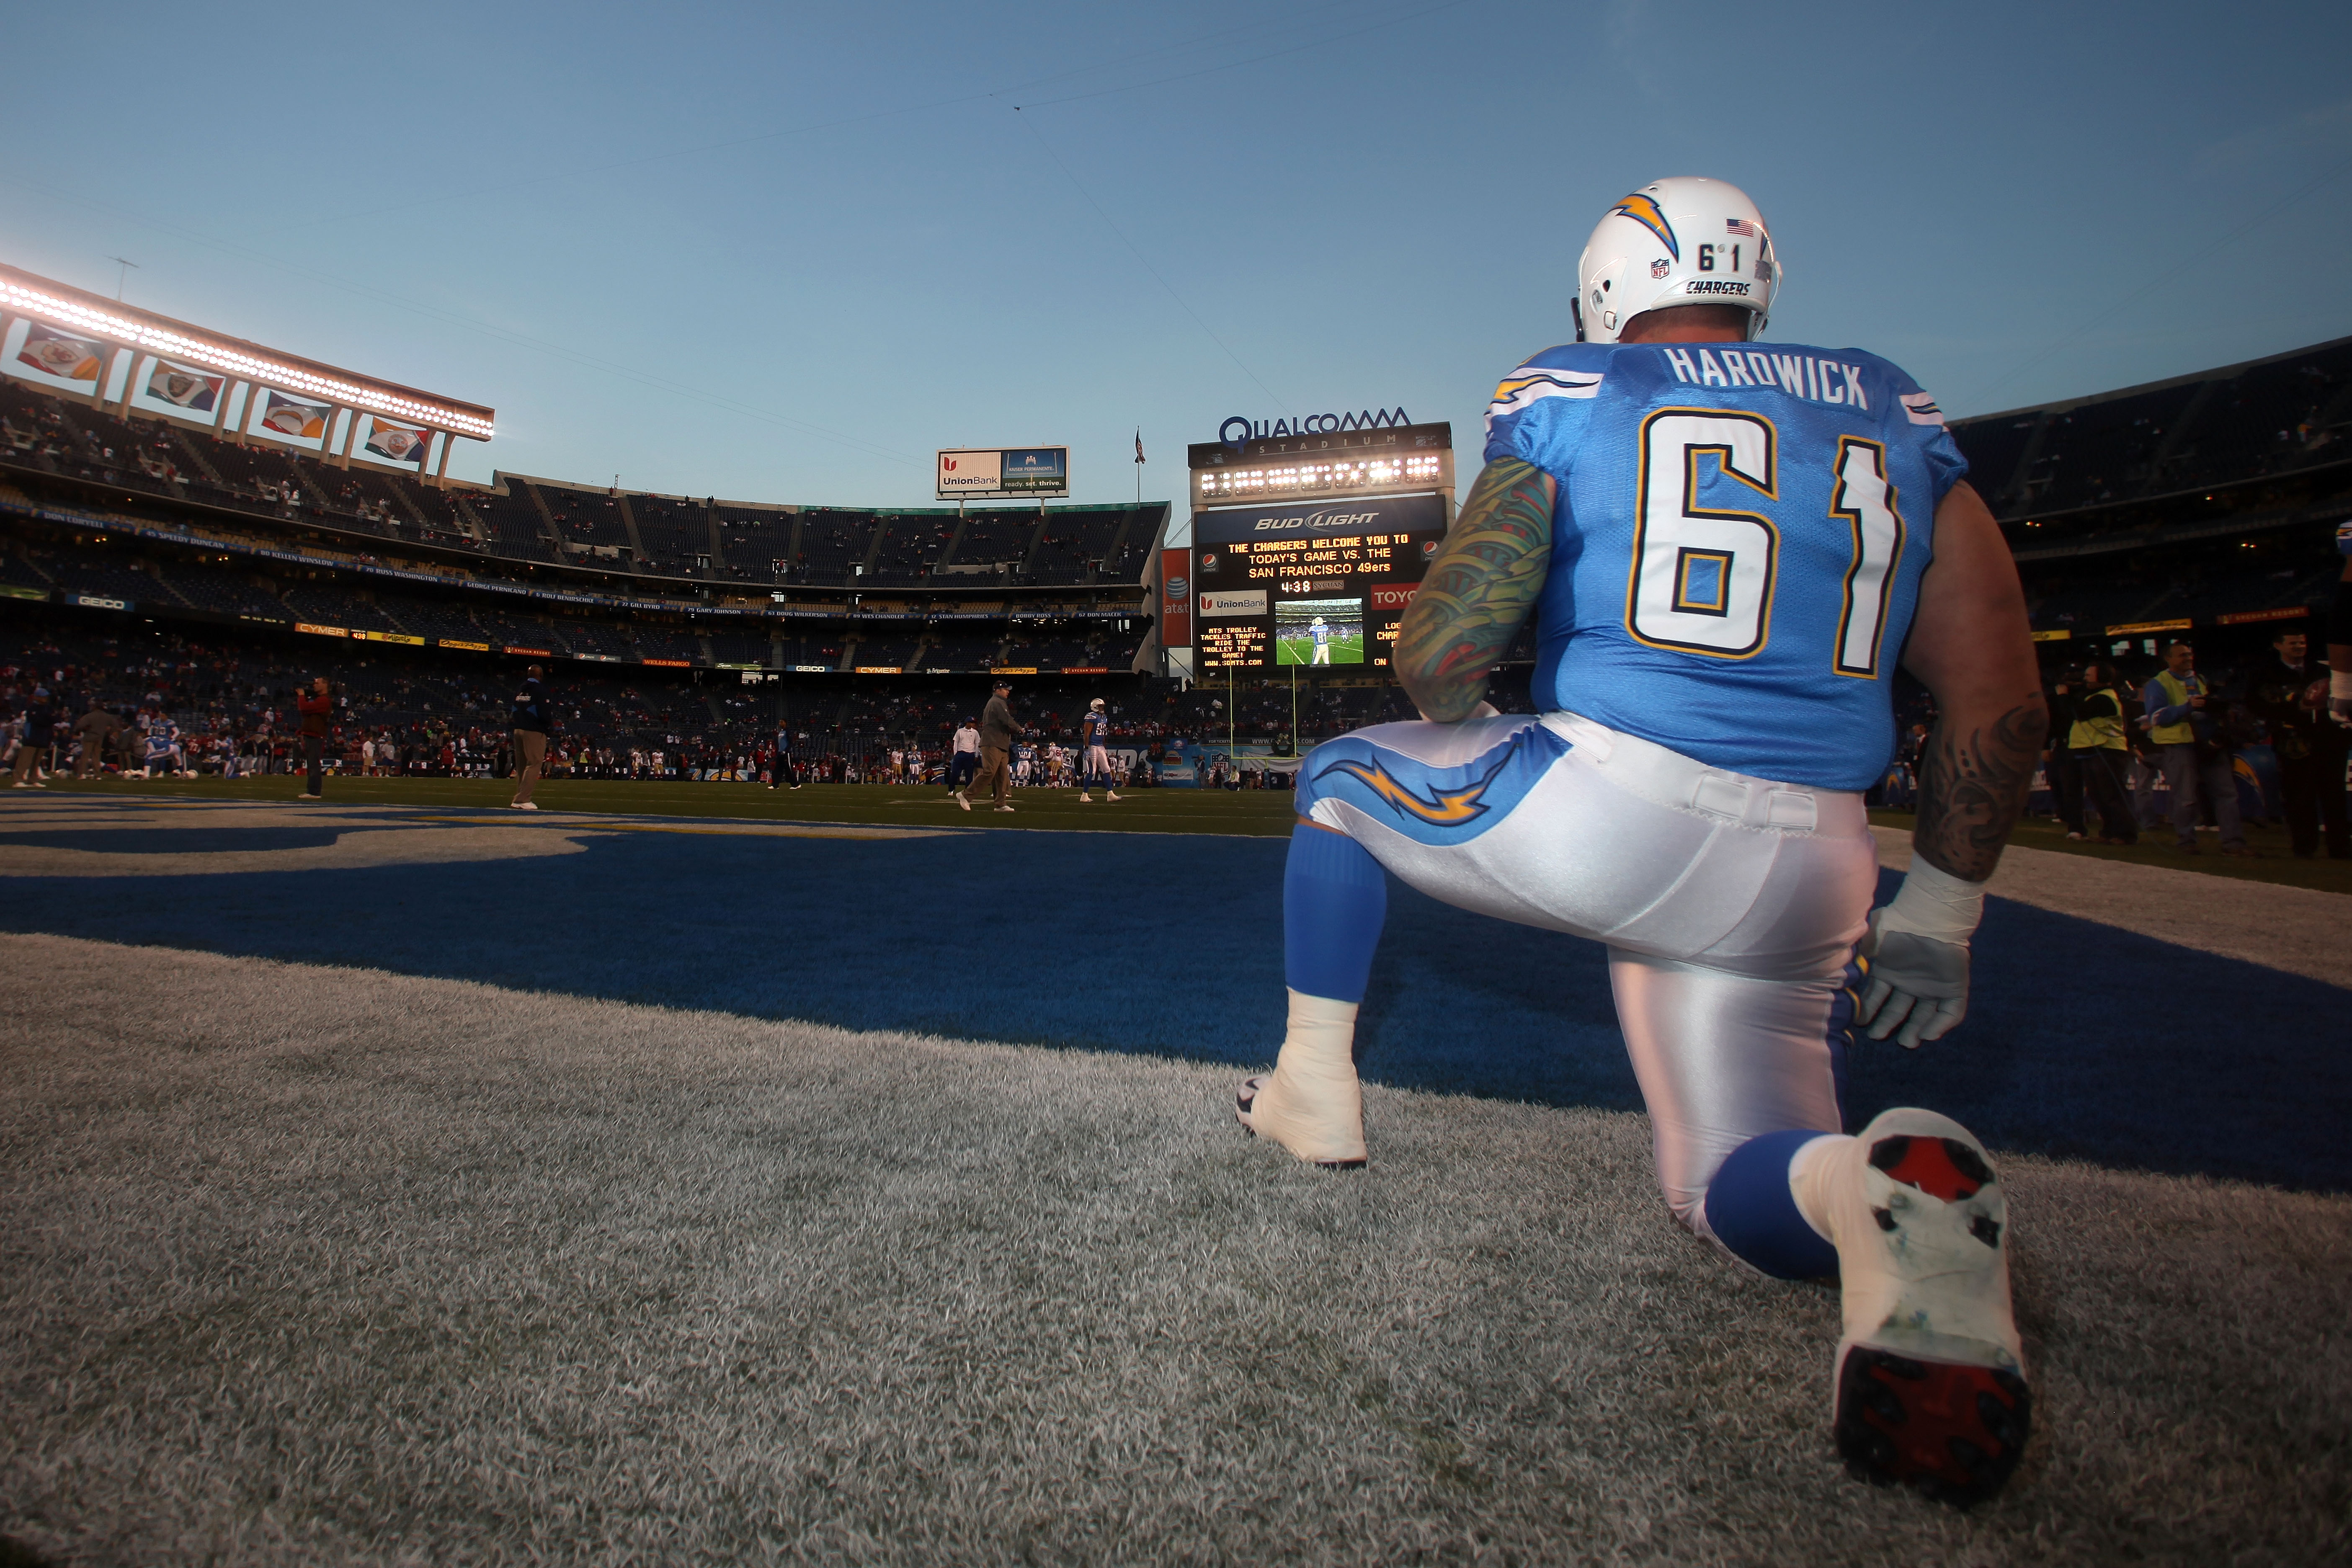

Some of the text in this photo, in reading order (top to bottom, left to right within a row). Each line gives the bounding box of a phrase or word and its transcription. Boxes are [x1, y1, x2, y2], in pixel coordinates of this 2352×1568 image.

[1700, 244, 1739, 273] 61
[1652, 267, 1668, 276] NFL
[1686, 281, 1751, 296] CHARGERS
[1663, 348, 1868, 410] HARDWICK
[1219, 407, 1411, 454] QUALCOMM
[1259, 434, 1395, 454] STADIUM
[943, 476, 998, 485] UnionBank
[1254, 512, 1379, 530] BUD LIGHT
[190, 537, 225, 549] DUNCAN
[1228, 534, 1409, 553] THE CHARGERS WELCOME YOU TO
[1625, 405, 1906, 679] 61
[272, 551, 297, 561] KELLEN
[299, 556, 334, 567] WINSLOW
[1249, 548, 1391, 564] TODAY'S GAME VS. THE
[394, 570, 438, 582] WASHINGTON
[1249, 562, 1391, 578] SAN FRANCISCO 49ers
[1281, 580, 1311, 593] 4:38
[78, 596, 125, 609] GEICO
[1165, 603, 1189, 614] at&t
[1217, 599, 1265, 608] UnionBank
[300, 624, 345, 636] CYMER
